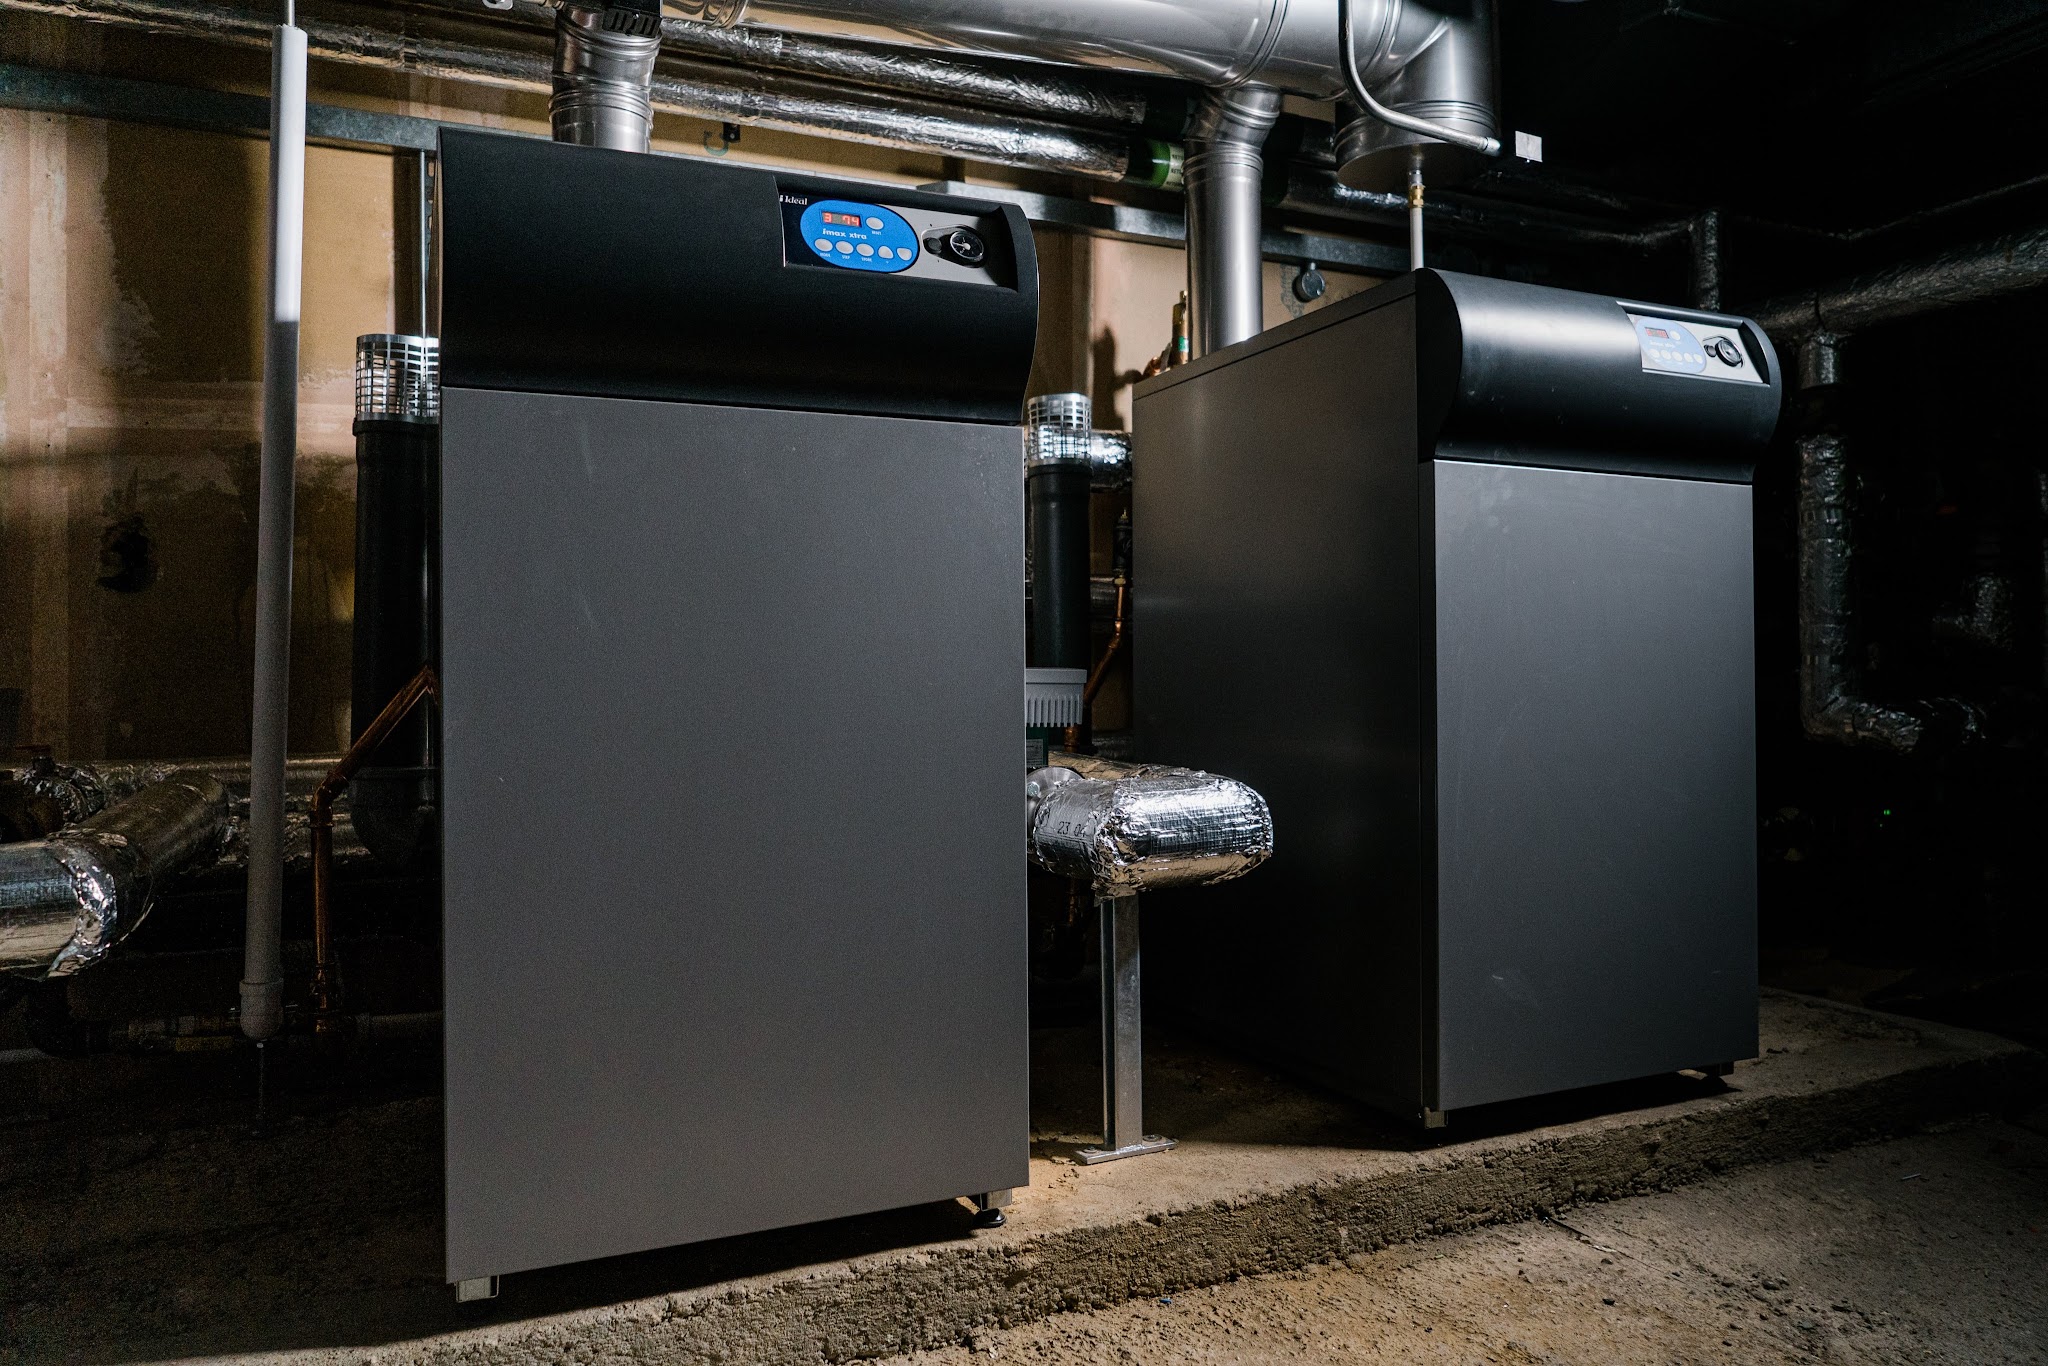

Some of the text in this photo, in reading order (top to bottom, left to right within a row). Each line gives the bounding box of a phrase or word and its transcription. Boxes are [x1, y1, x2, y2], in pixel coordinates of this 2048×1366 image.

[785, 196, 808, 205] Ideal
[824, 212, 860, 226] 3 74
[823, 228, 846, 237] imax
[849, 232, 867, 240] xtra
[1057, 821, 1071, 835] 23
